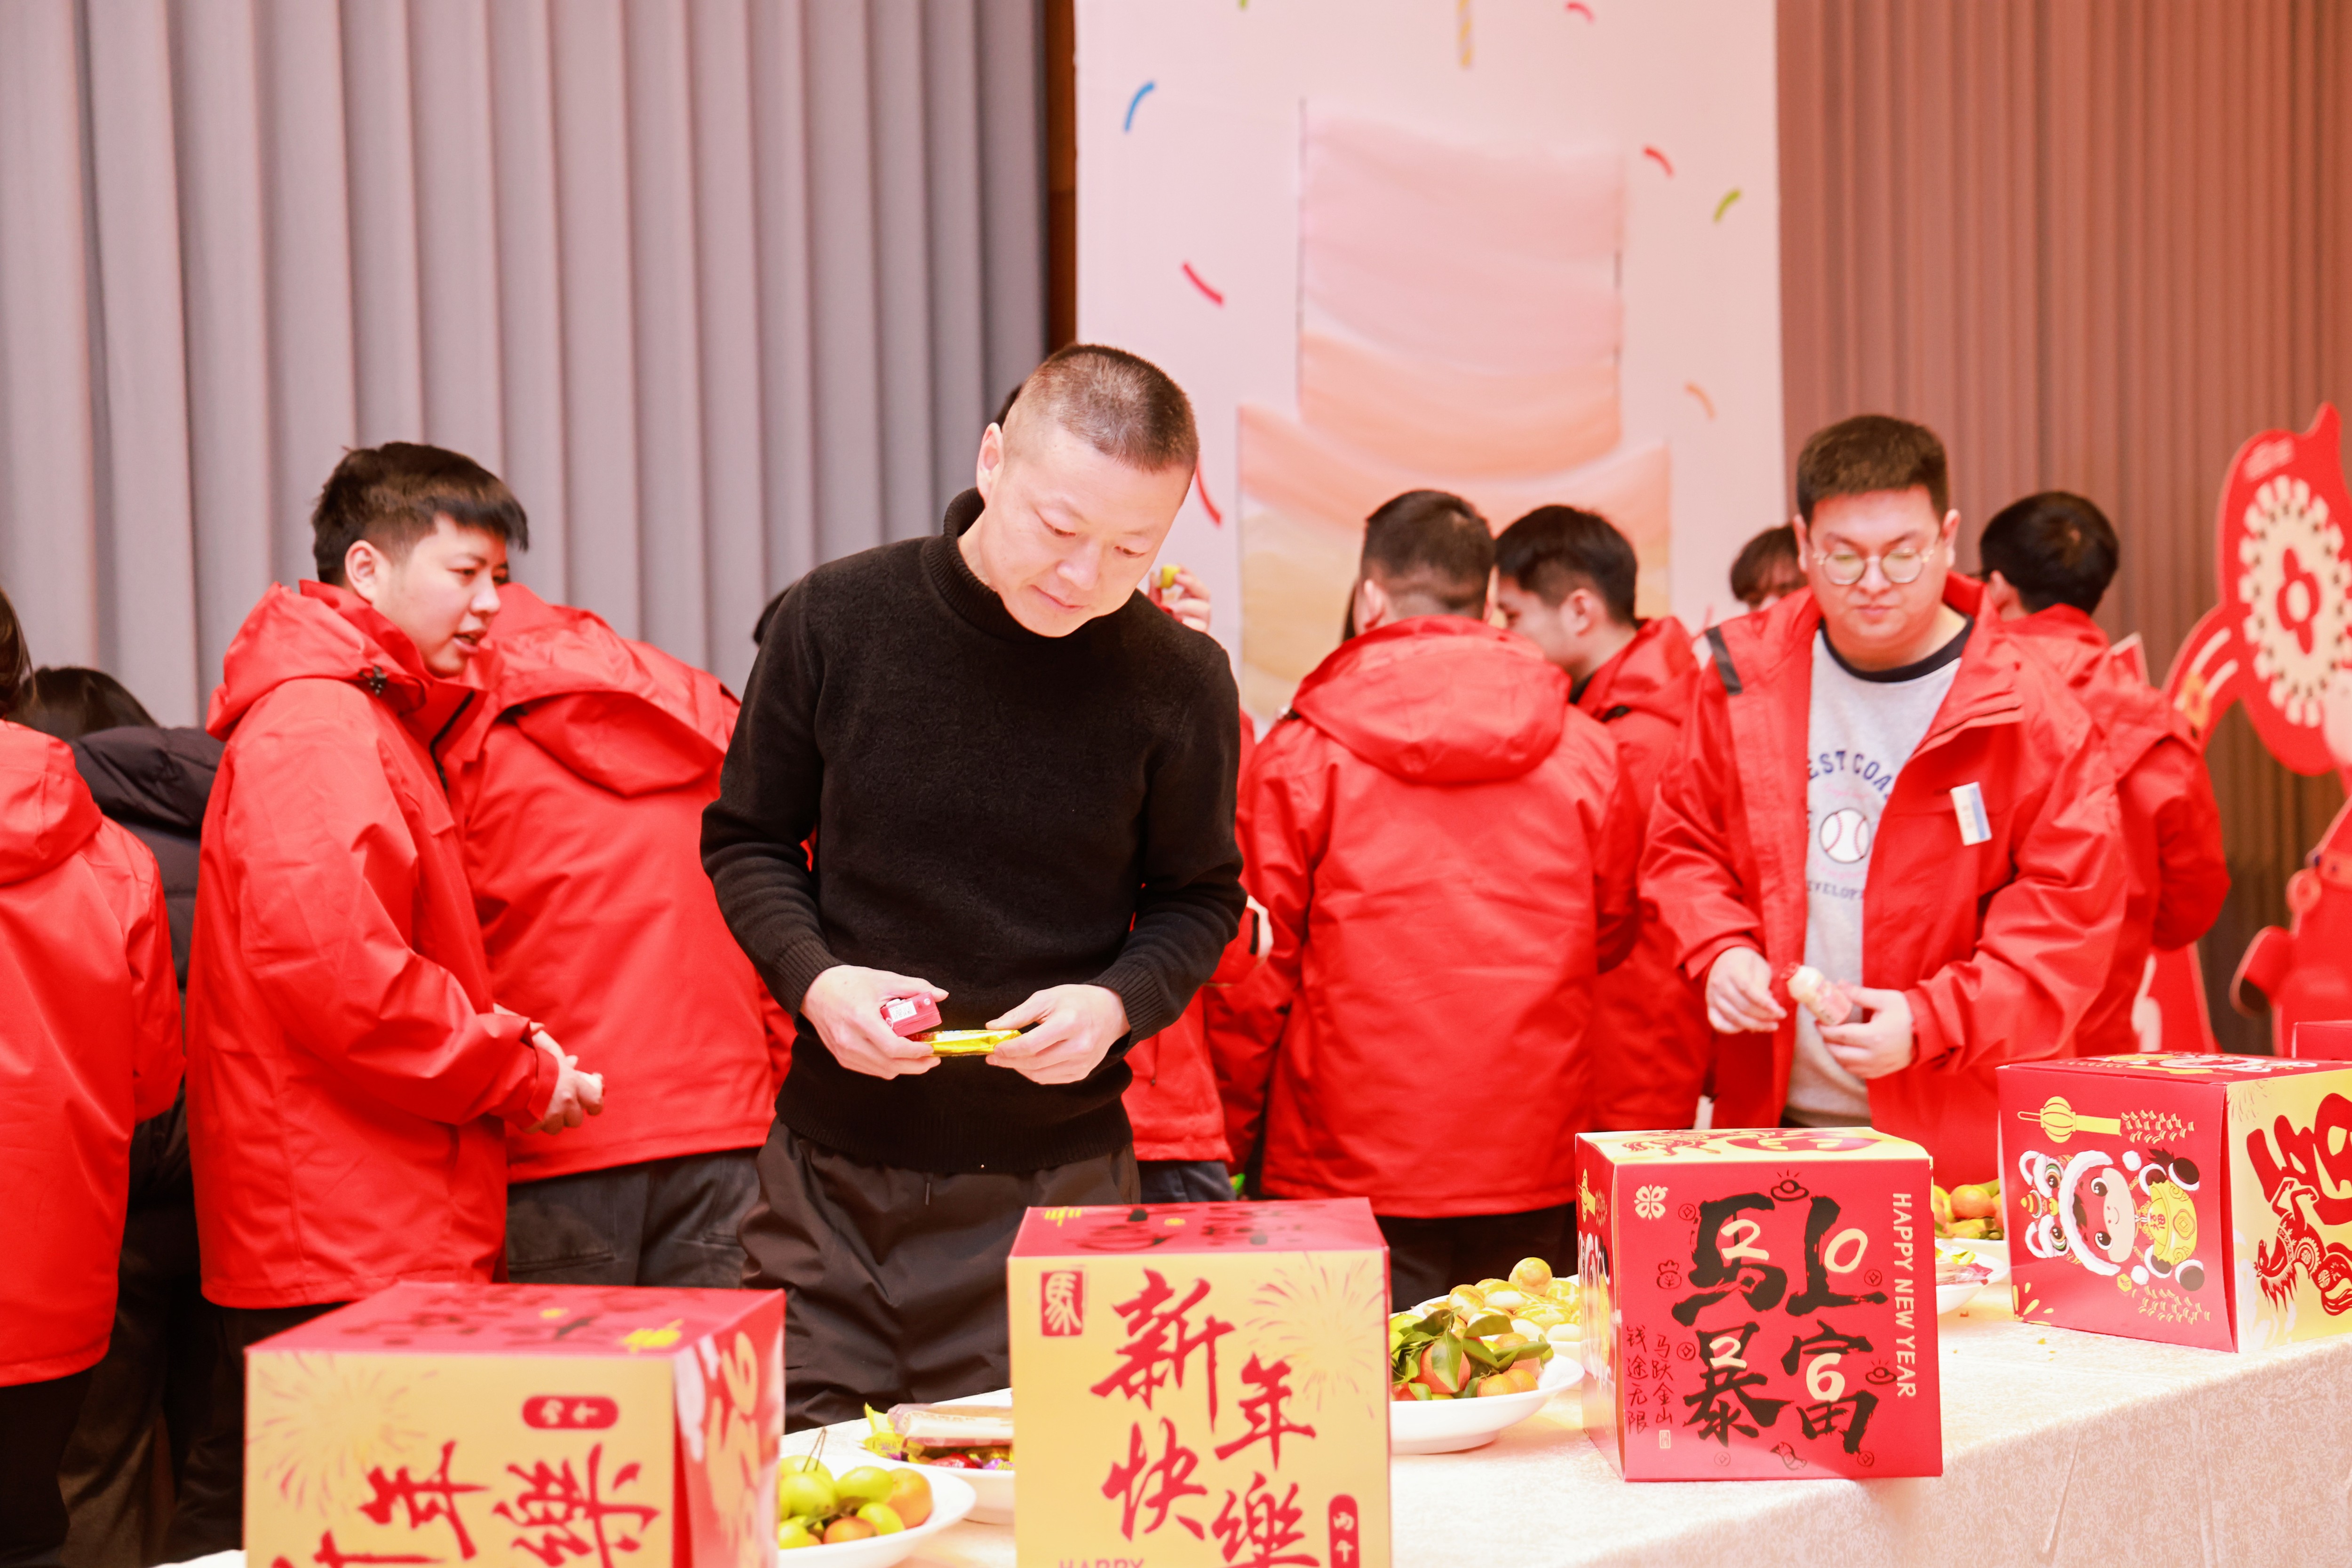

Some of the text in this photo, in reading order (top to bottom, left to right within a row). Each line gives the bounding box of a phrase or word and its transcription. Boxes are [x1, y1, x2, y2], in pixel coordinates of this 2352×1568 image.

[1853, 754, 1892, 800] COA
[2150, 1212, 2166, 1231] 福
[1892, 1193, 1917, 1397] HAPPY NEW YEAR
[1626, 1324, 1649, 1435] 钱途无限
[1651, 1334, 1674, 1425] 马跃金山
